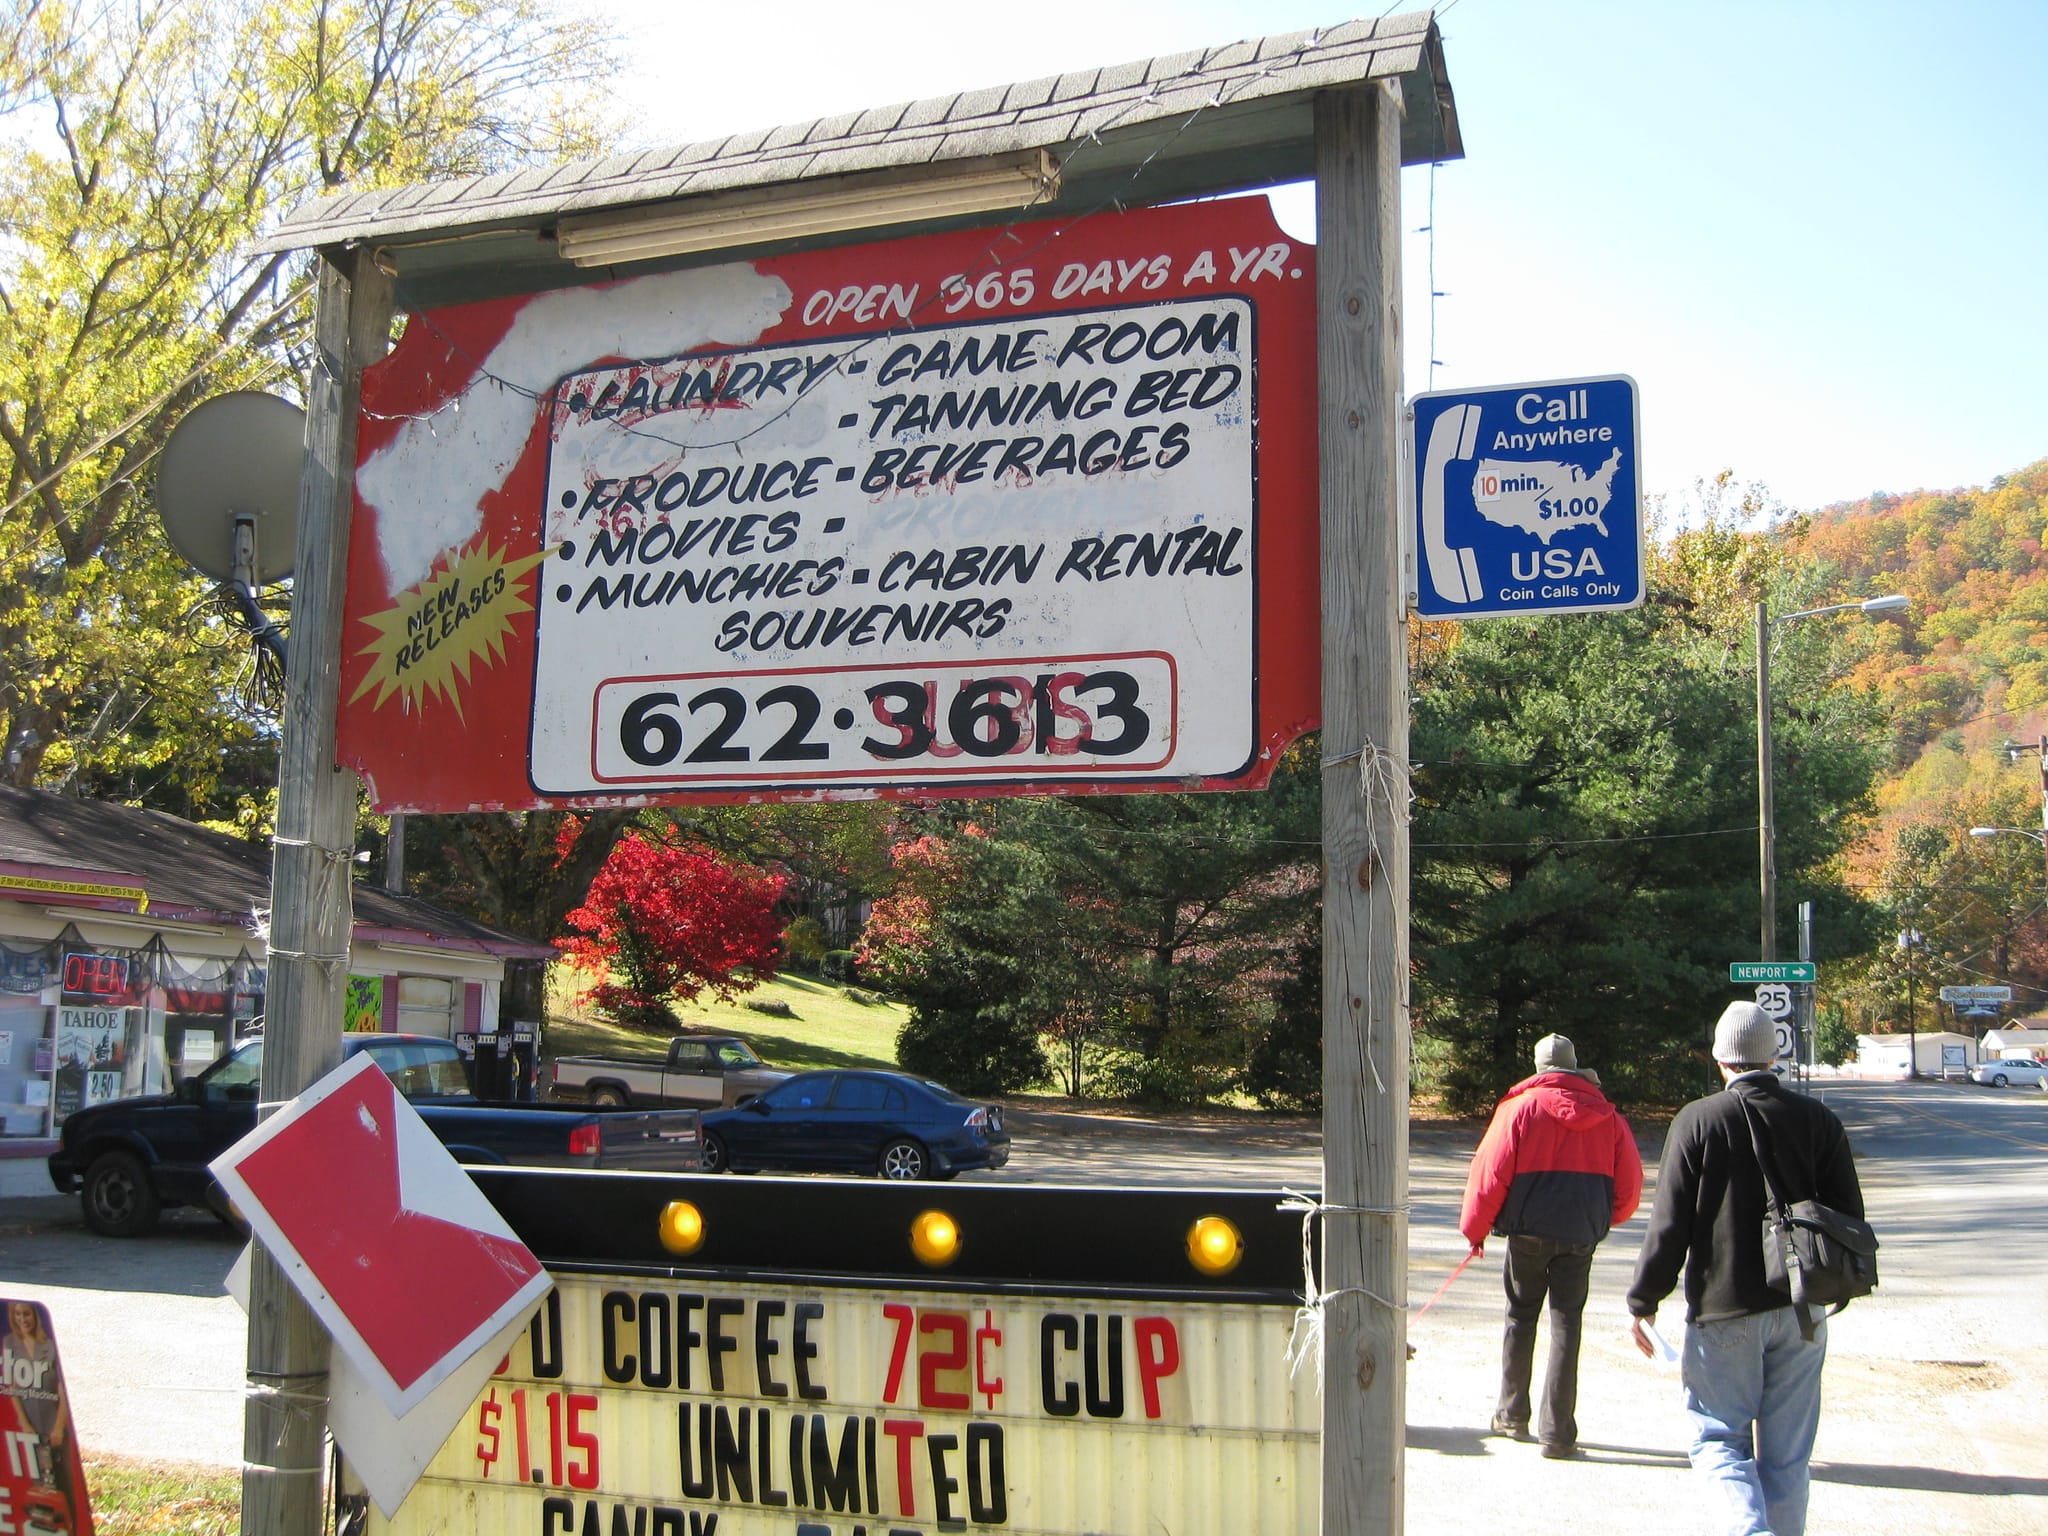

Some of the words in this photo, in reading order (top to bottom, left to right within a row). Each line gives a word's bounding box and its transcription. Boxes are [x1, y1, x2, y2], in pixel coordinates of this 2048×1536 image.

[802, 283, 919, 326] OPEN
[941, 268, 1034, 313] 365
[1051, 255, 1172, 300] DAYS
[1184, 251, 1215, 287] A
[1228, 243, 1302, 282] YR.
[877, 330, 1038, 386] GAME
[1057, 312, 1239, 366] ROOM
[591, 354, 838, 420] LAUNDRY
[871, 381, 1116, 440] TANNING
[1123, 363, 1242, 415] BED
[1515, 389, 1588, 425] Call
[859, 424, 1191, 496] BEVERAGES
[1493, 426, 1613, 452] Anywhere
[579, 457, 833, 520] PRODUCE
[1481, 476, 1498, 496] 10
[1501, 473, 1545, 492] min.
[1539, 496, 1599, 521] $1.00
[585, 512, 802, 570] MOVIES
[879, 542, 1044, 594] CABIN
[1055, 526, 1244, 584] RENTAL
[1511, 547, 1605, 581] USA
[408, 578, 460, 637] NEW
[576, 556, 842, 614] MUNCHIES
[1500, 588, 1535, 601] Coin
[1541, 584, 1579, 600] Calls
[1585, 582, 1621, 597] Only
[396, 568, 506, 676] RELEASES
[714, 597, 1013, 651] SOUVENIRS
[65, 956, 126, 993] OPEN
[1738, 967, 1788, 978] NEWPORT
[1759, 991, 1786, 1011] 25
[62, 1010, 118, 1029] TAHOE
[602, 1291, 826, 1400] COFFEE
[882, 1303, 1003, 1412] 72¢
[1041, 1313, 1180, 1419] CUP
[5, 1430, 41, 1479] IT
[476, 1387, 600, 1490] $1.15
[679, 1402, 1008, 1533] UNLIMITED
